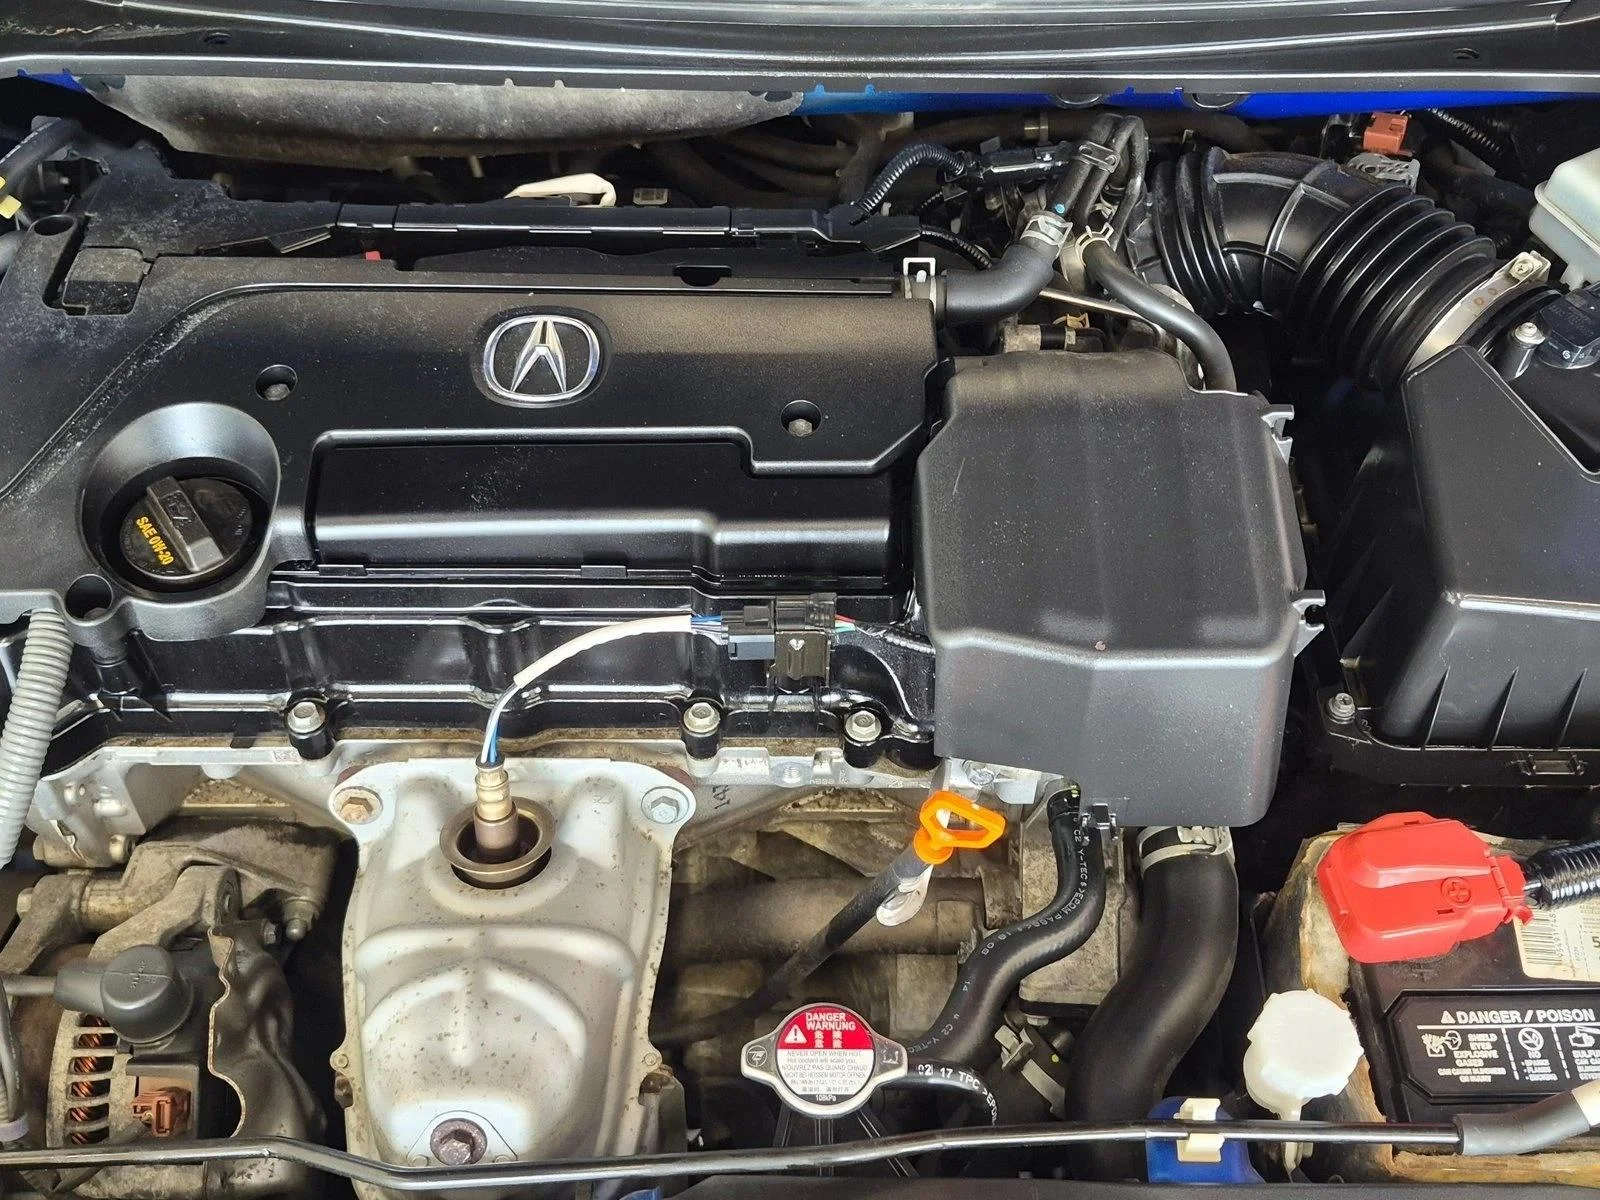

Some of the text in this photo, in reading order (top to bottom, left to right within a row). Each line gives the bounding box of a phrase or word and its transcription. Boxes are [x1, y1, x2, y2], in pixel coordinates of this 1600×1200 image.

[135, 516, 175, 566] SAE 0W-20
[805, 1012, 847, 1022] DANGER
[1455, 1010, 1522, 1024] DANGER
[1535, 1009, 1596, 1022] POISON
[805, 1021, 857, 1031] WARNUNG
[1467, 1033, 1498, 1042] SHIELD
[1453, 1049, 1499, 1059] EXPLOSIVE
[1527, 1050, 1542, 1059] NO
[939, 1067, 953, 1079] 17
[958, 1070, 981, 1090] TPC
